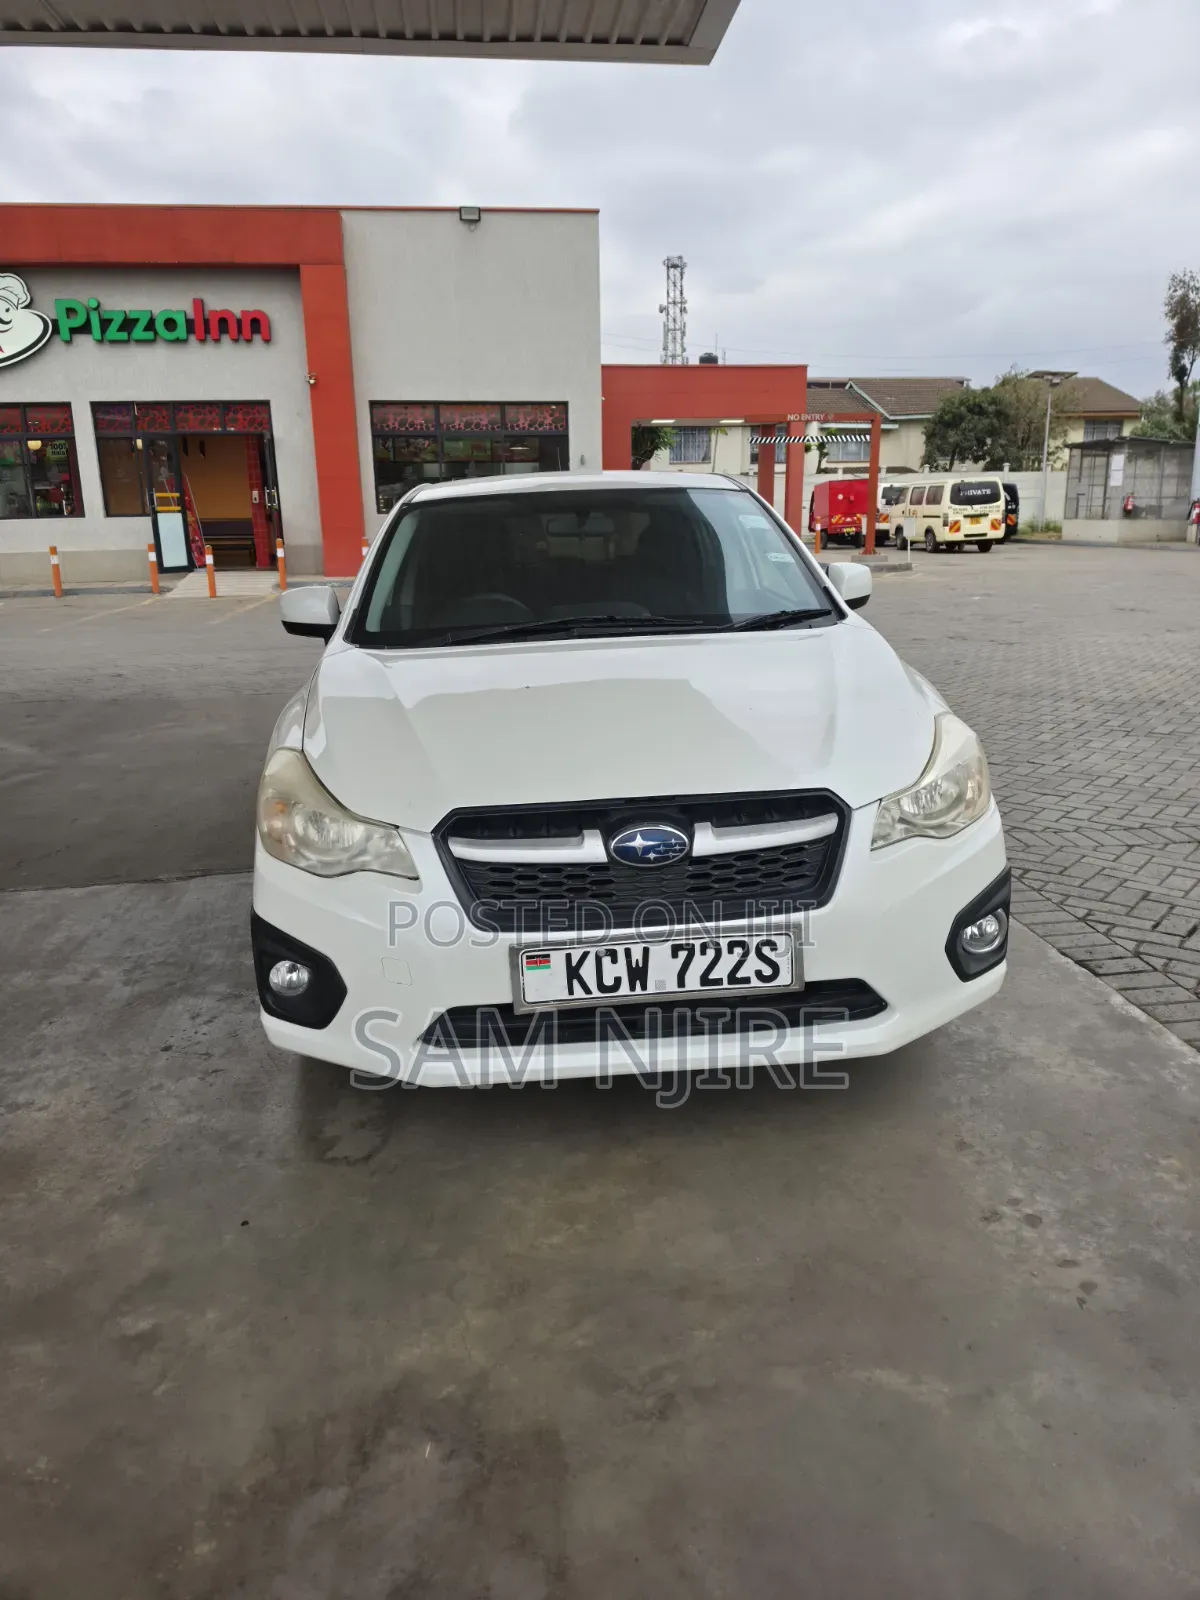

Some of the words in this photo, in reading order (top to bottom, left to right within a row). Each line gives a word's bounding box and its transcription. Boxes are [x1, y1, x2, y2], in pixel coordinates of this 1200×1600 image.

[787, 413, 800, 421] NO
[801, 413, 825, 421] ENTRY
[960, 488, 991, 496] PRIVATE
[565, 946, 650, 996] KCW
[671, 938, 780, 989] 722S
